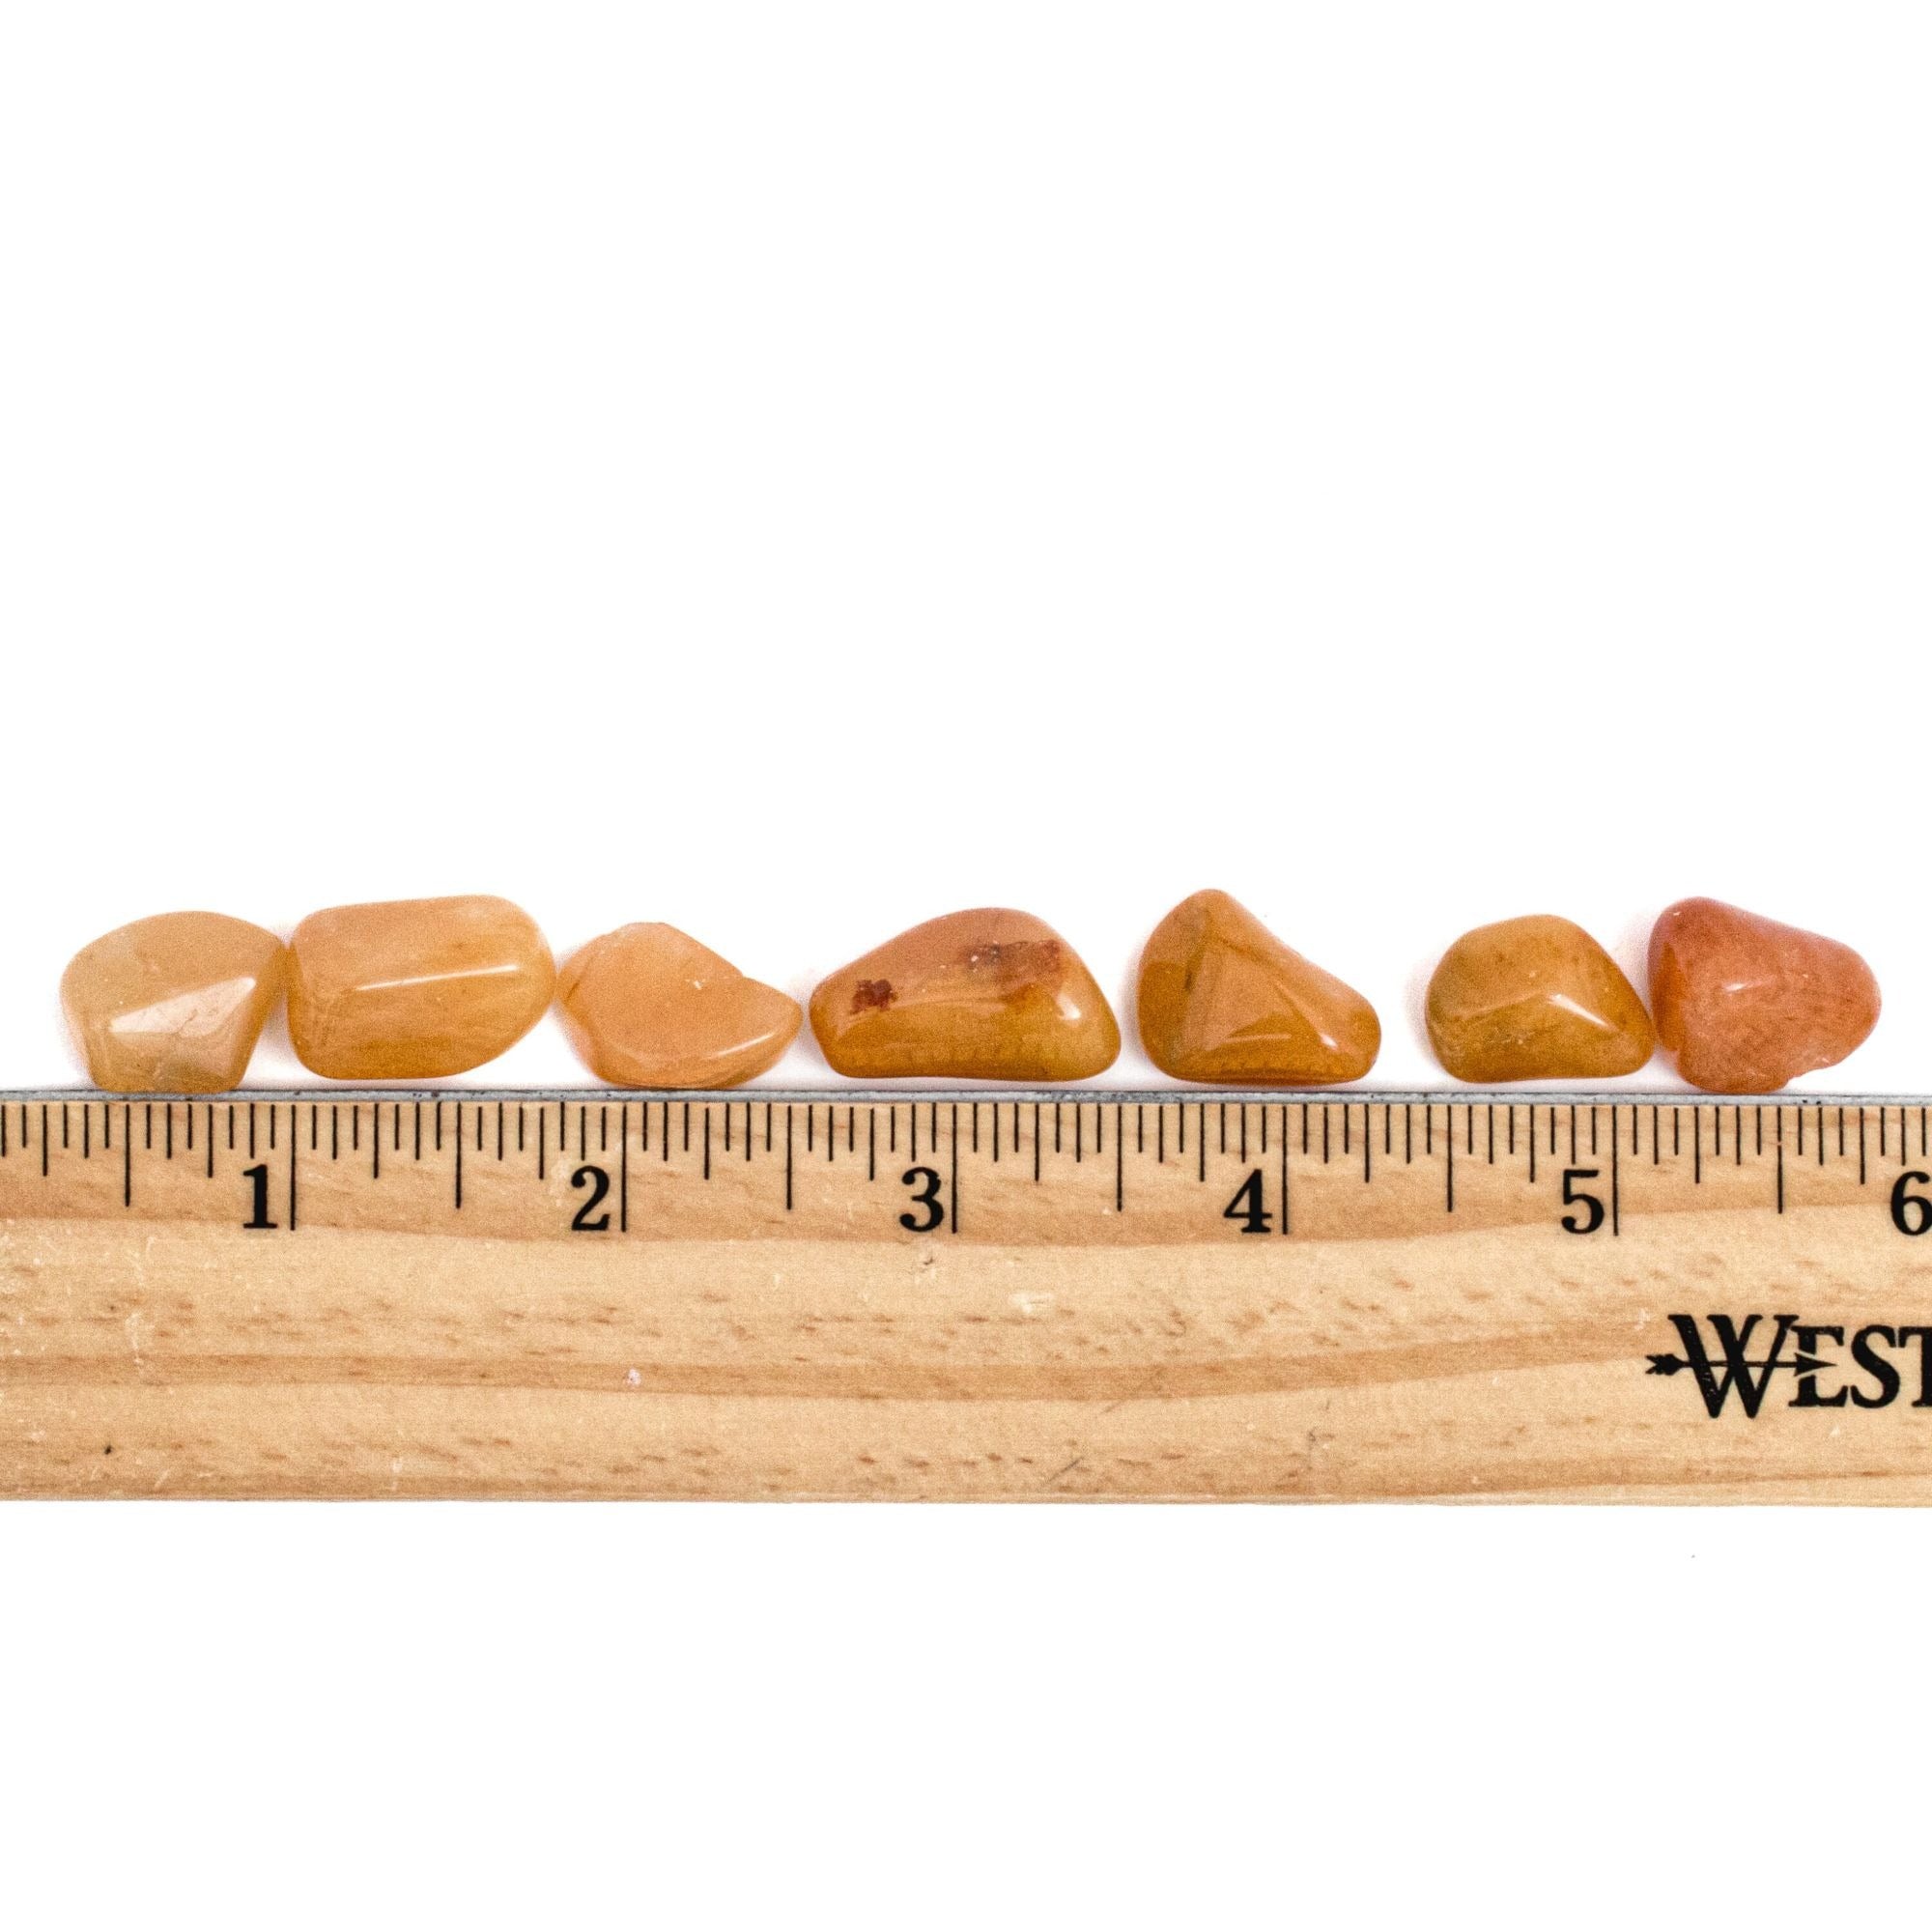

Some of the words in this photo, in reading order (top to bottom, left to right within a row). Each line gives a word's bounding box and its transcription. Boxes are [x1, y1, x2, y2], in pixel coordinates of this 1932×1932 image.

[242, 1164, 278, 1230] 1
[570, 1165, 611, 1232] 2
[898, 1166, 945, 1234] 3
[1223, 1168, 1273, 1235] 4
[1560, 1169, 1605, 1235] 5
[1890, 1171, 1932, 1236] 6
[1667, 1314, 1932, 1419] WEST
